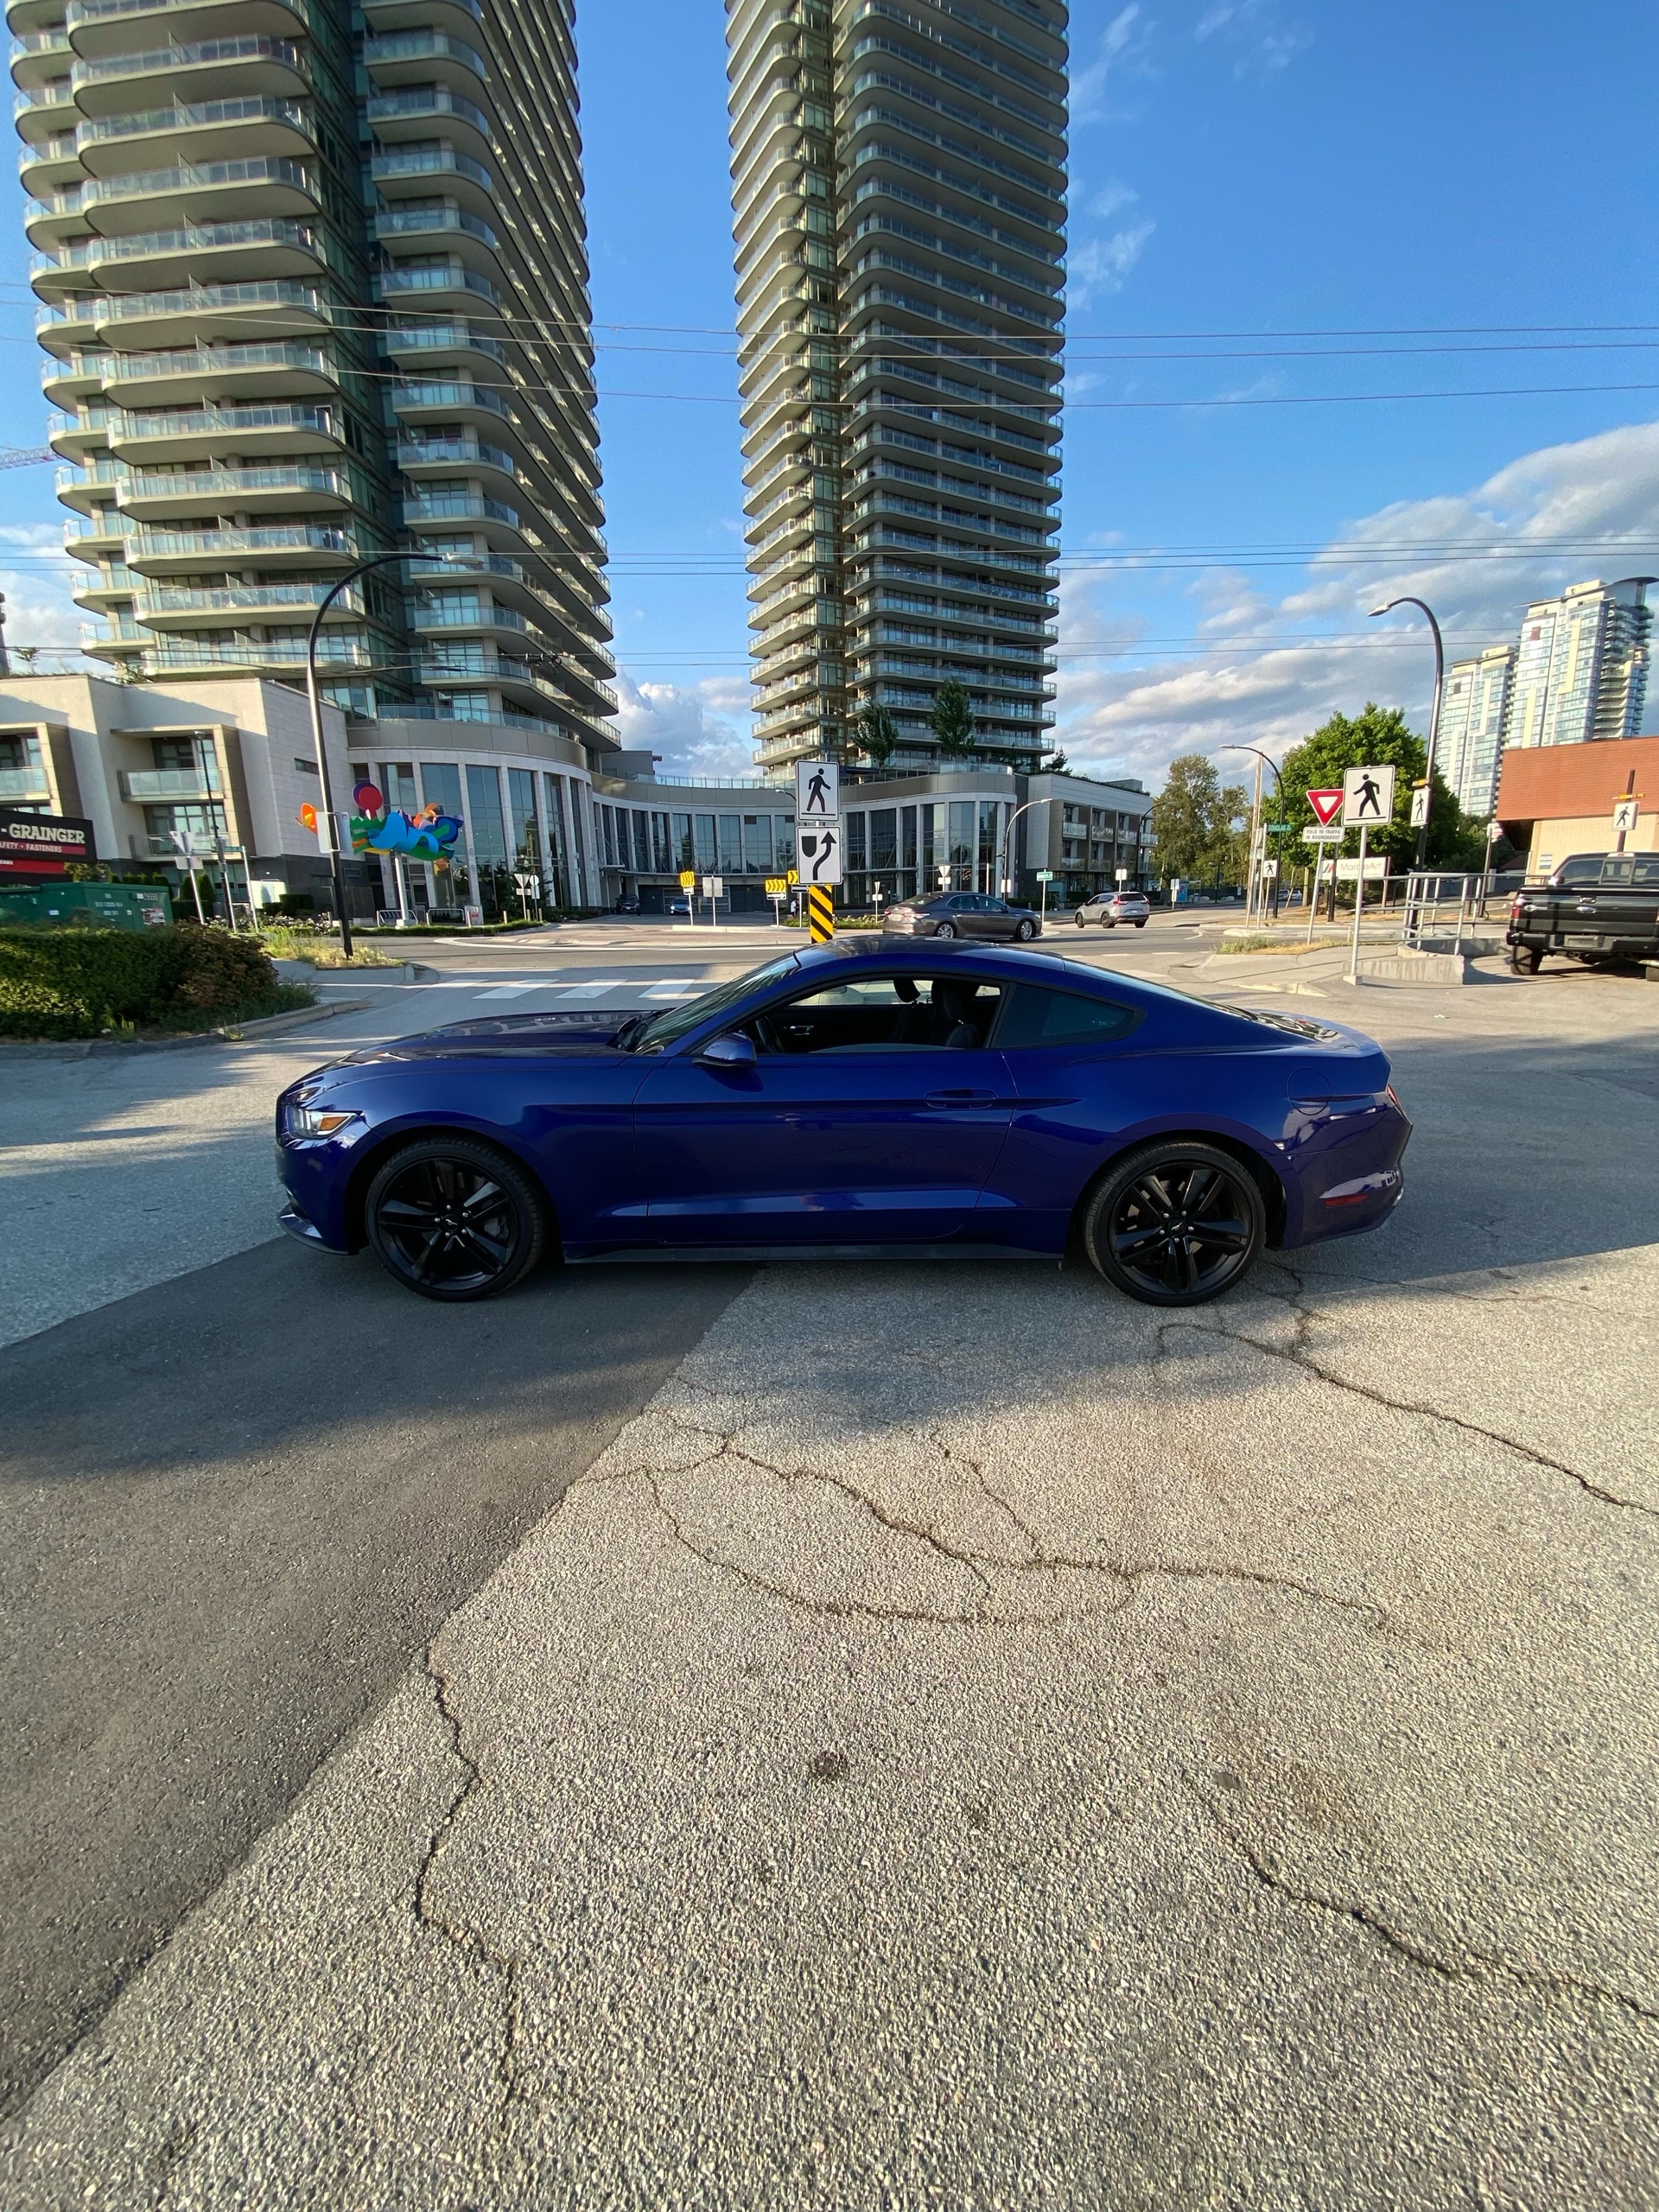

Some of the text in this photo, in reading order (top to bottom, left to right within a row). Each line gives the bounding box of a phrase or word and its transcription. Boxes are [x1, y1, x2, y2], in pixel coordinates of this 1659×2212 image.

[10, 823, 86, 844] GRAINGER
[26, 843, 62, 853] FASTENERS
[1340, 862, 1382, 871] MarbeArt
